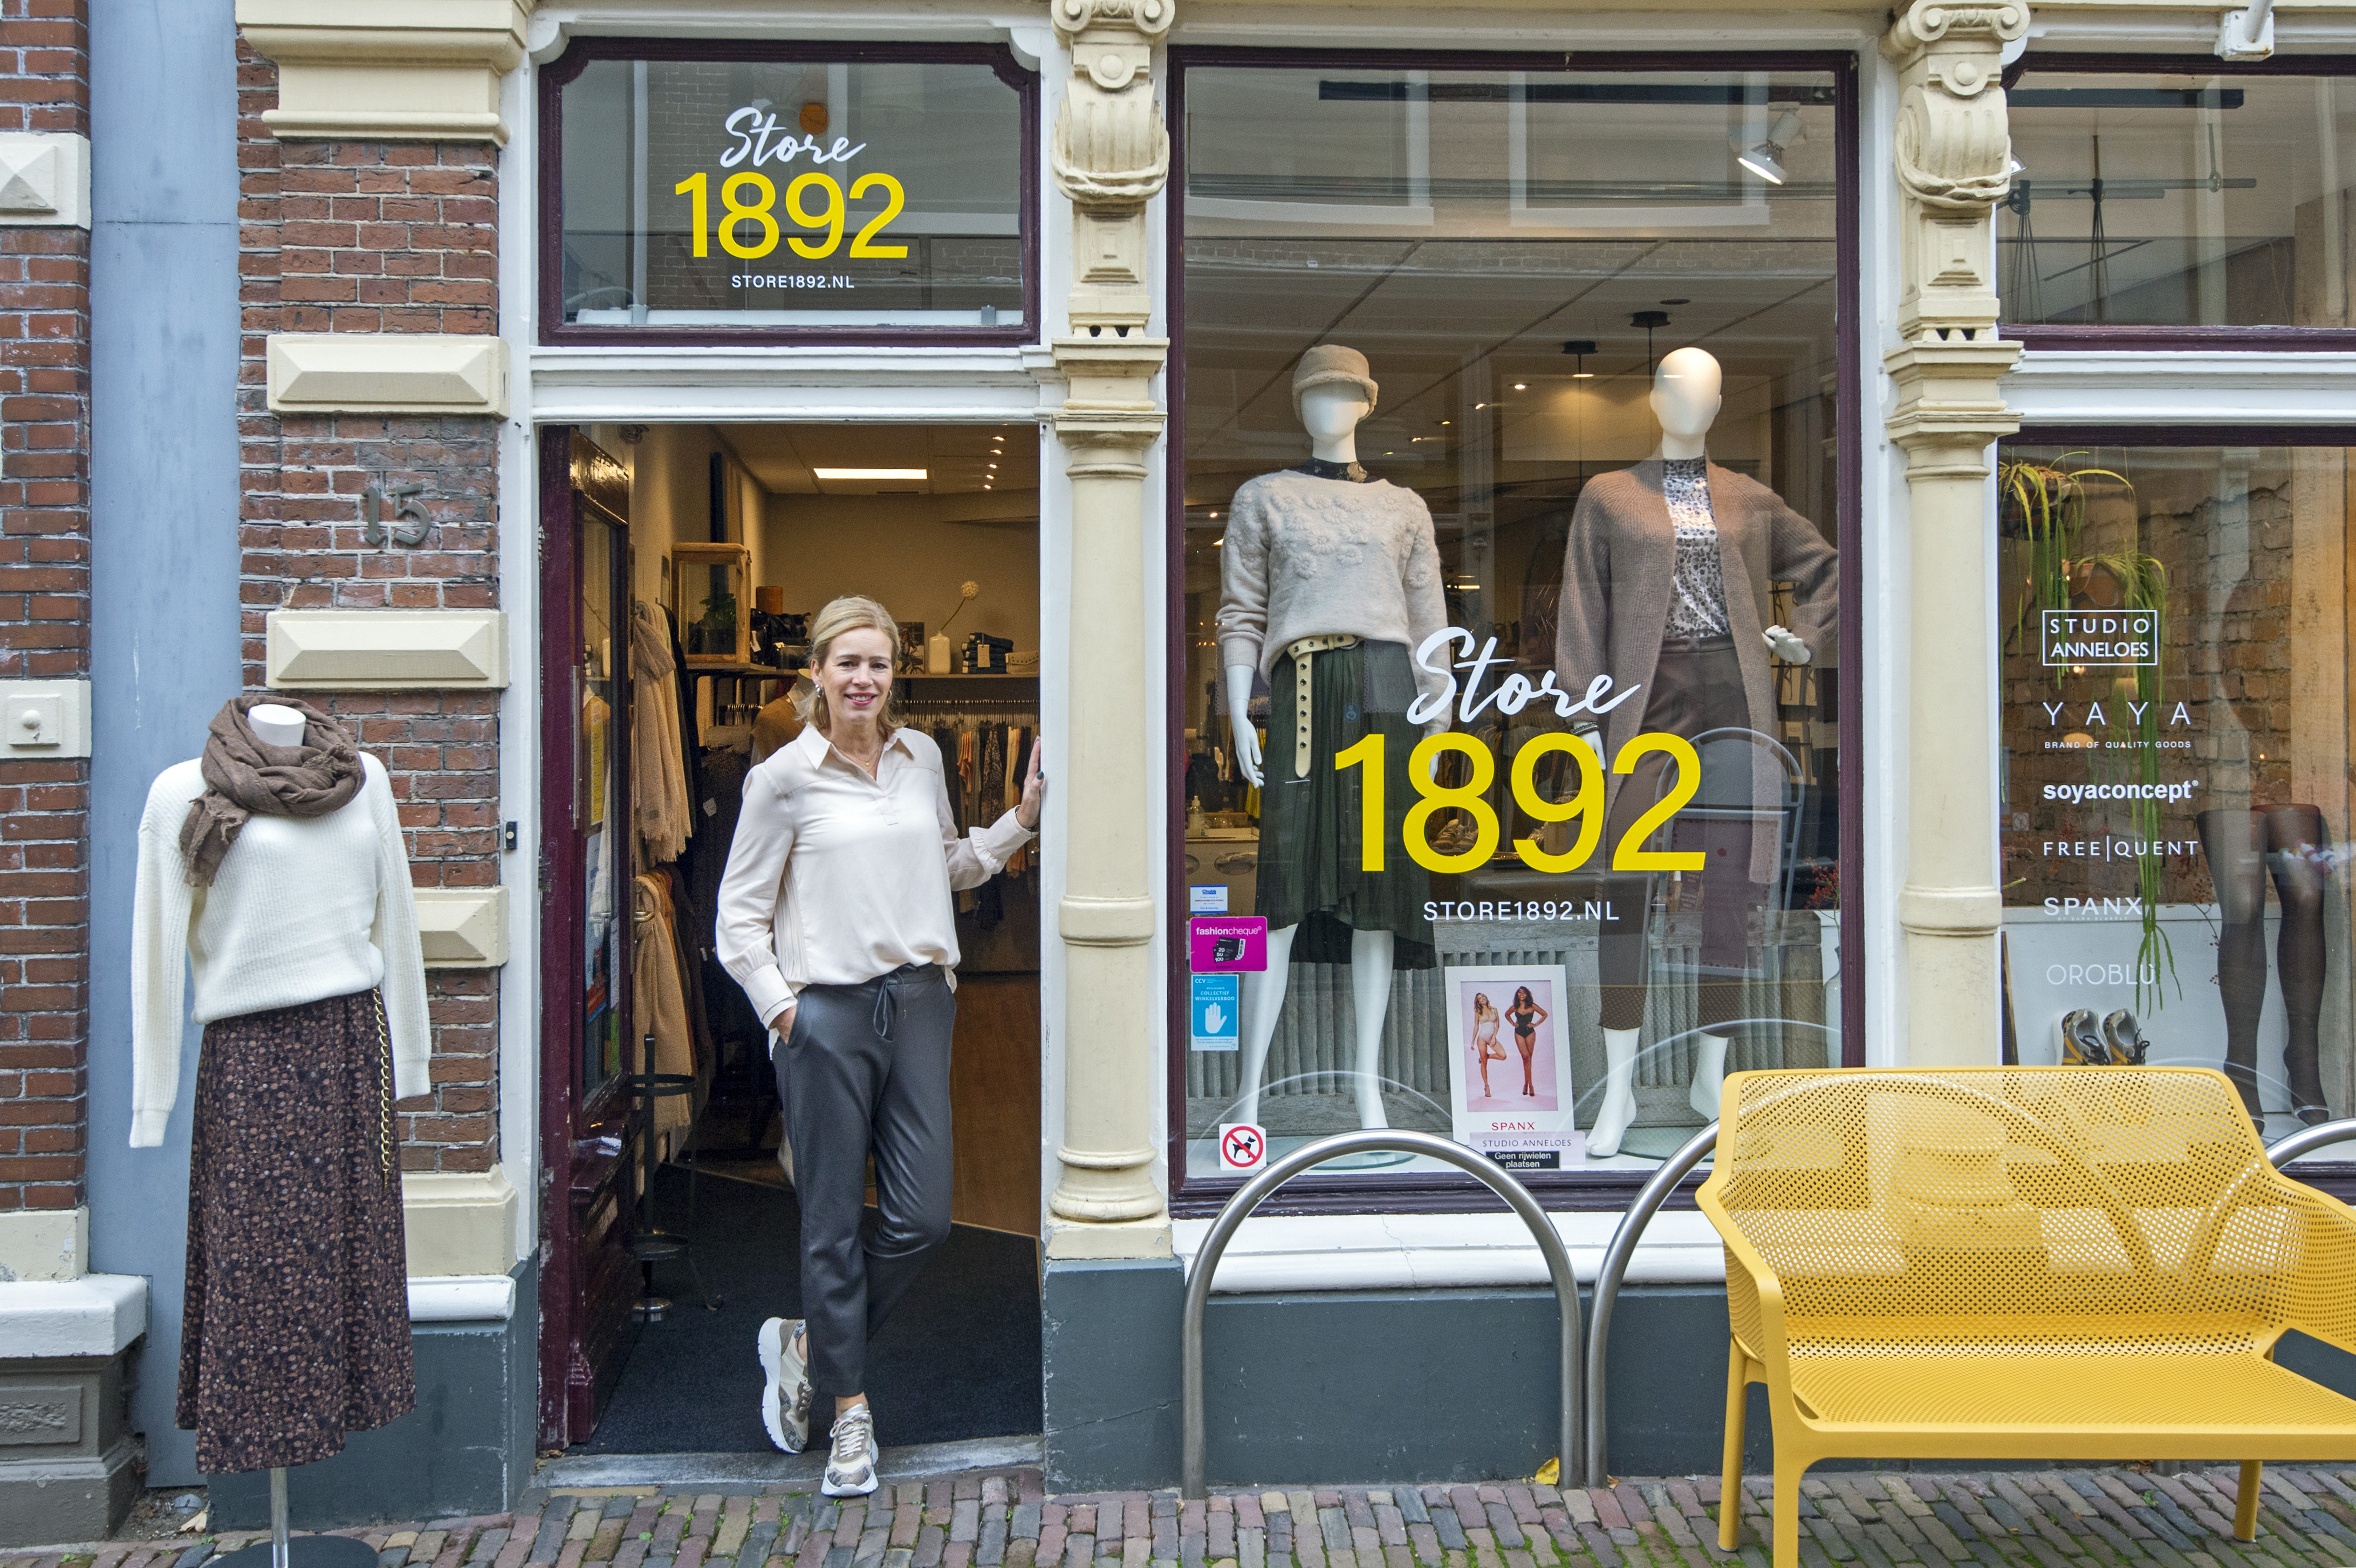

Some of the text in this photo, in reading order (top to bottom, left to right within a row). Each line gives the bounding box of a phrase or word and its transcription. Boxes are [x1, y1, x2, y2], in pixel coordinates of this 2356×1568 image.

[720, 106, 867, 168] Store
[675, 171, 908, 259] 1892
[731, 275, 854, 289] STORE1892.NL
[361, 481, 431, 545] 15
[2050, 618, 2150, 634] STUDIO
[2050, 641, 2149, 658] ANNELOES
[1406, 626, 1642, 725] Store
[1335, 732, 1707, 874] 1892
[1423, 901, 1620, 922] STORE1892.NL
[2043, 897, 2143, 916] SPANX
[1491, 1122, 1535, 1131] SPANX
[1505, 1160, 1540, 1169] plaatsen
[1518, 1152, 1551, 1160] rijwielen
